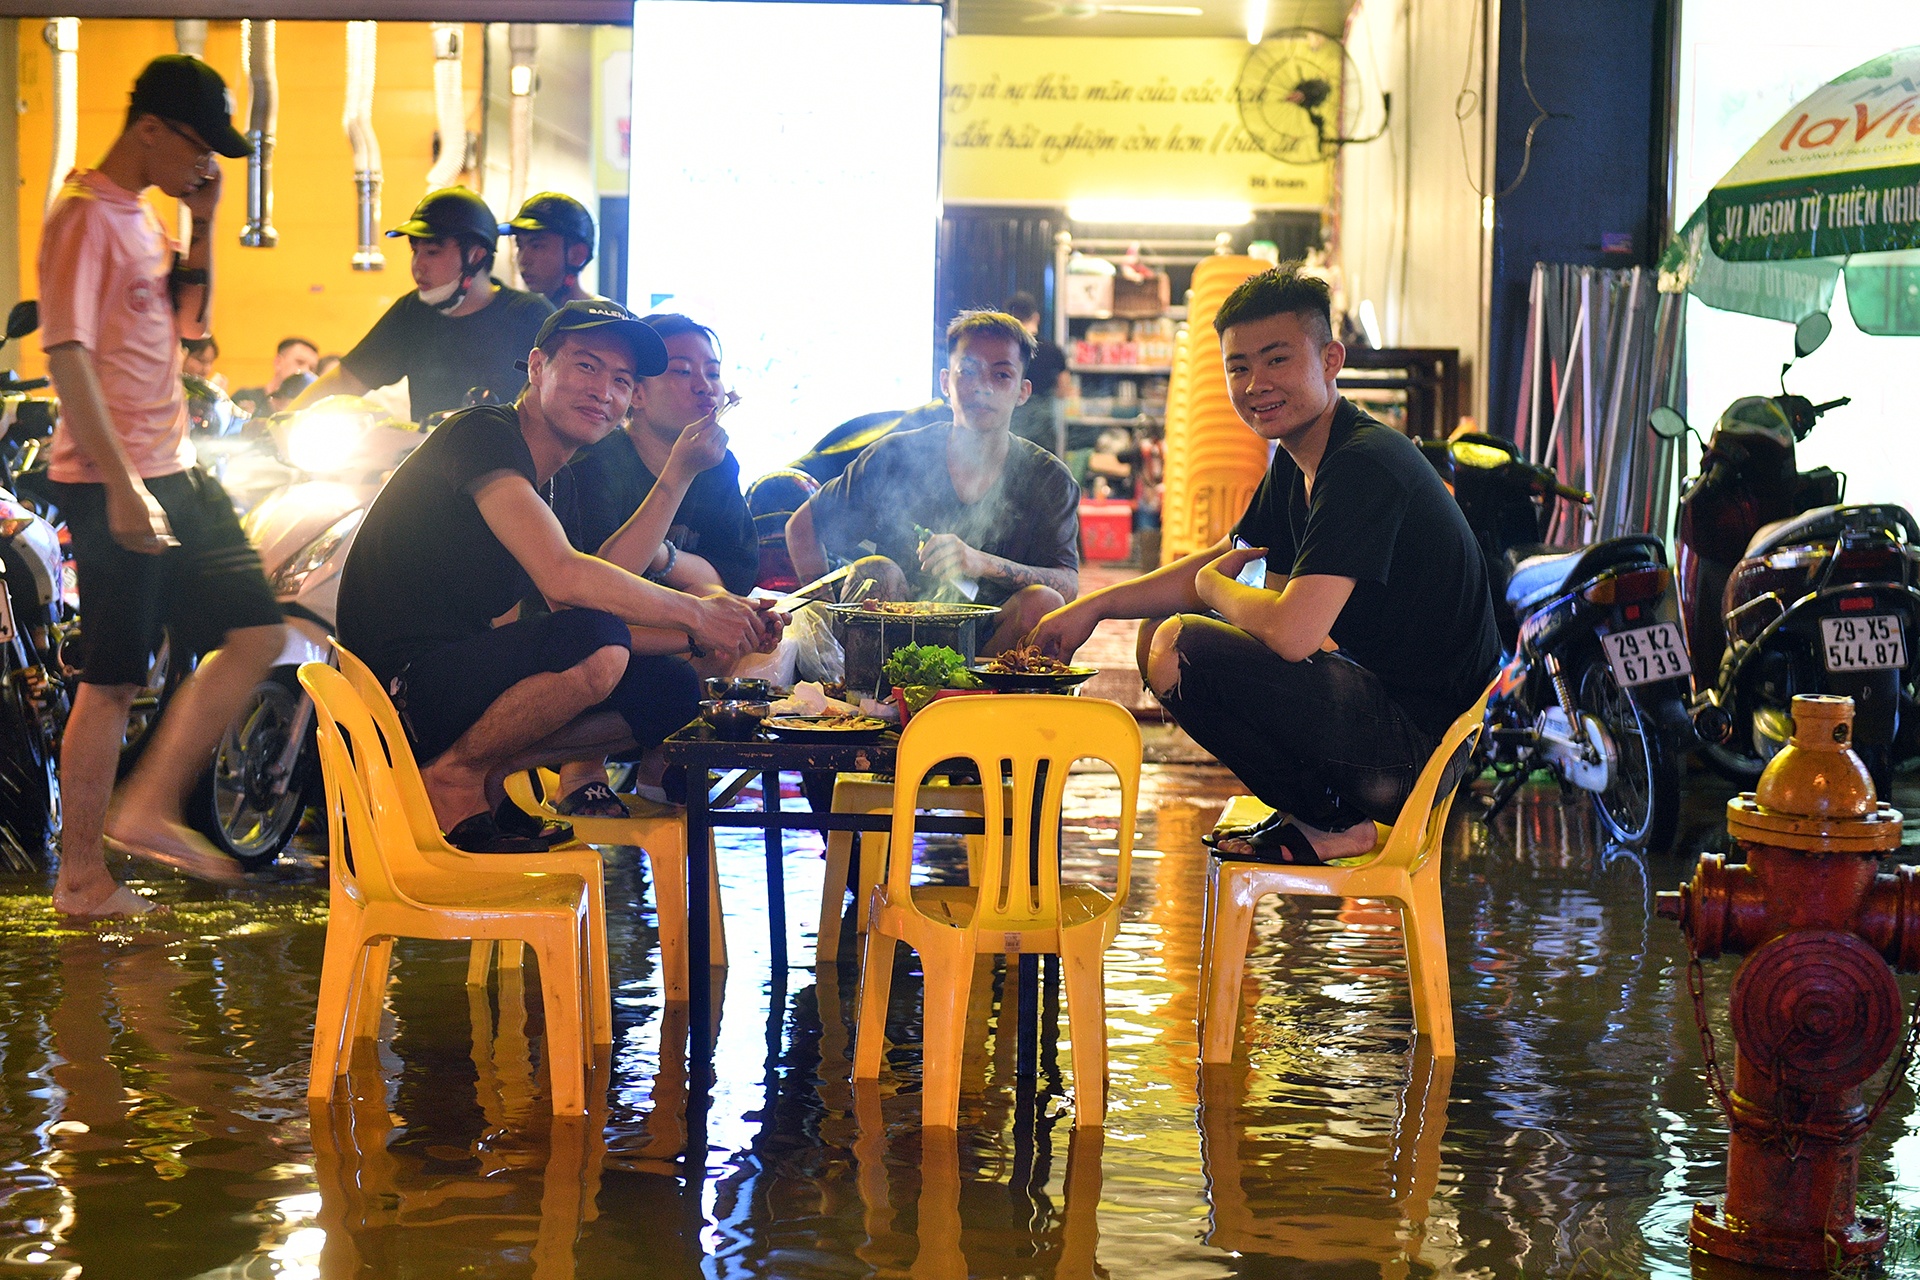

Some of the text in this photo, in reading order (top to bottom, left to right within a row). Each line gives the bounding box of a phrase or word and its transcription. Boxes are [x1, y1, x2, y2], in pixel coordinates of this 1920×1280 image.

[1137, 76, 1177, 102] của
[1164, 123, 1206, 152] hơn
[1725, 205, 1744, 244] VỊ
[1613, 626, 1674, 659] 29-K2
[1832, 617, 1890, 643] 29-X5
[1623, 650, 1682, 682] 6739
[1829, 642, 1899, 667] 544.87
